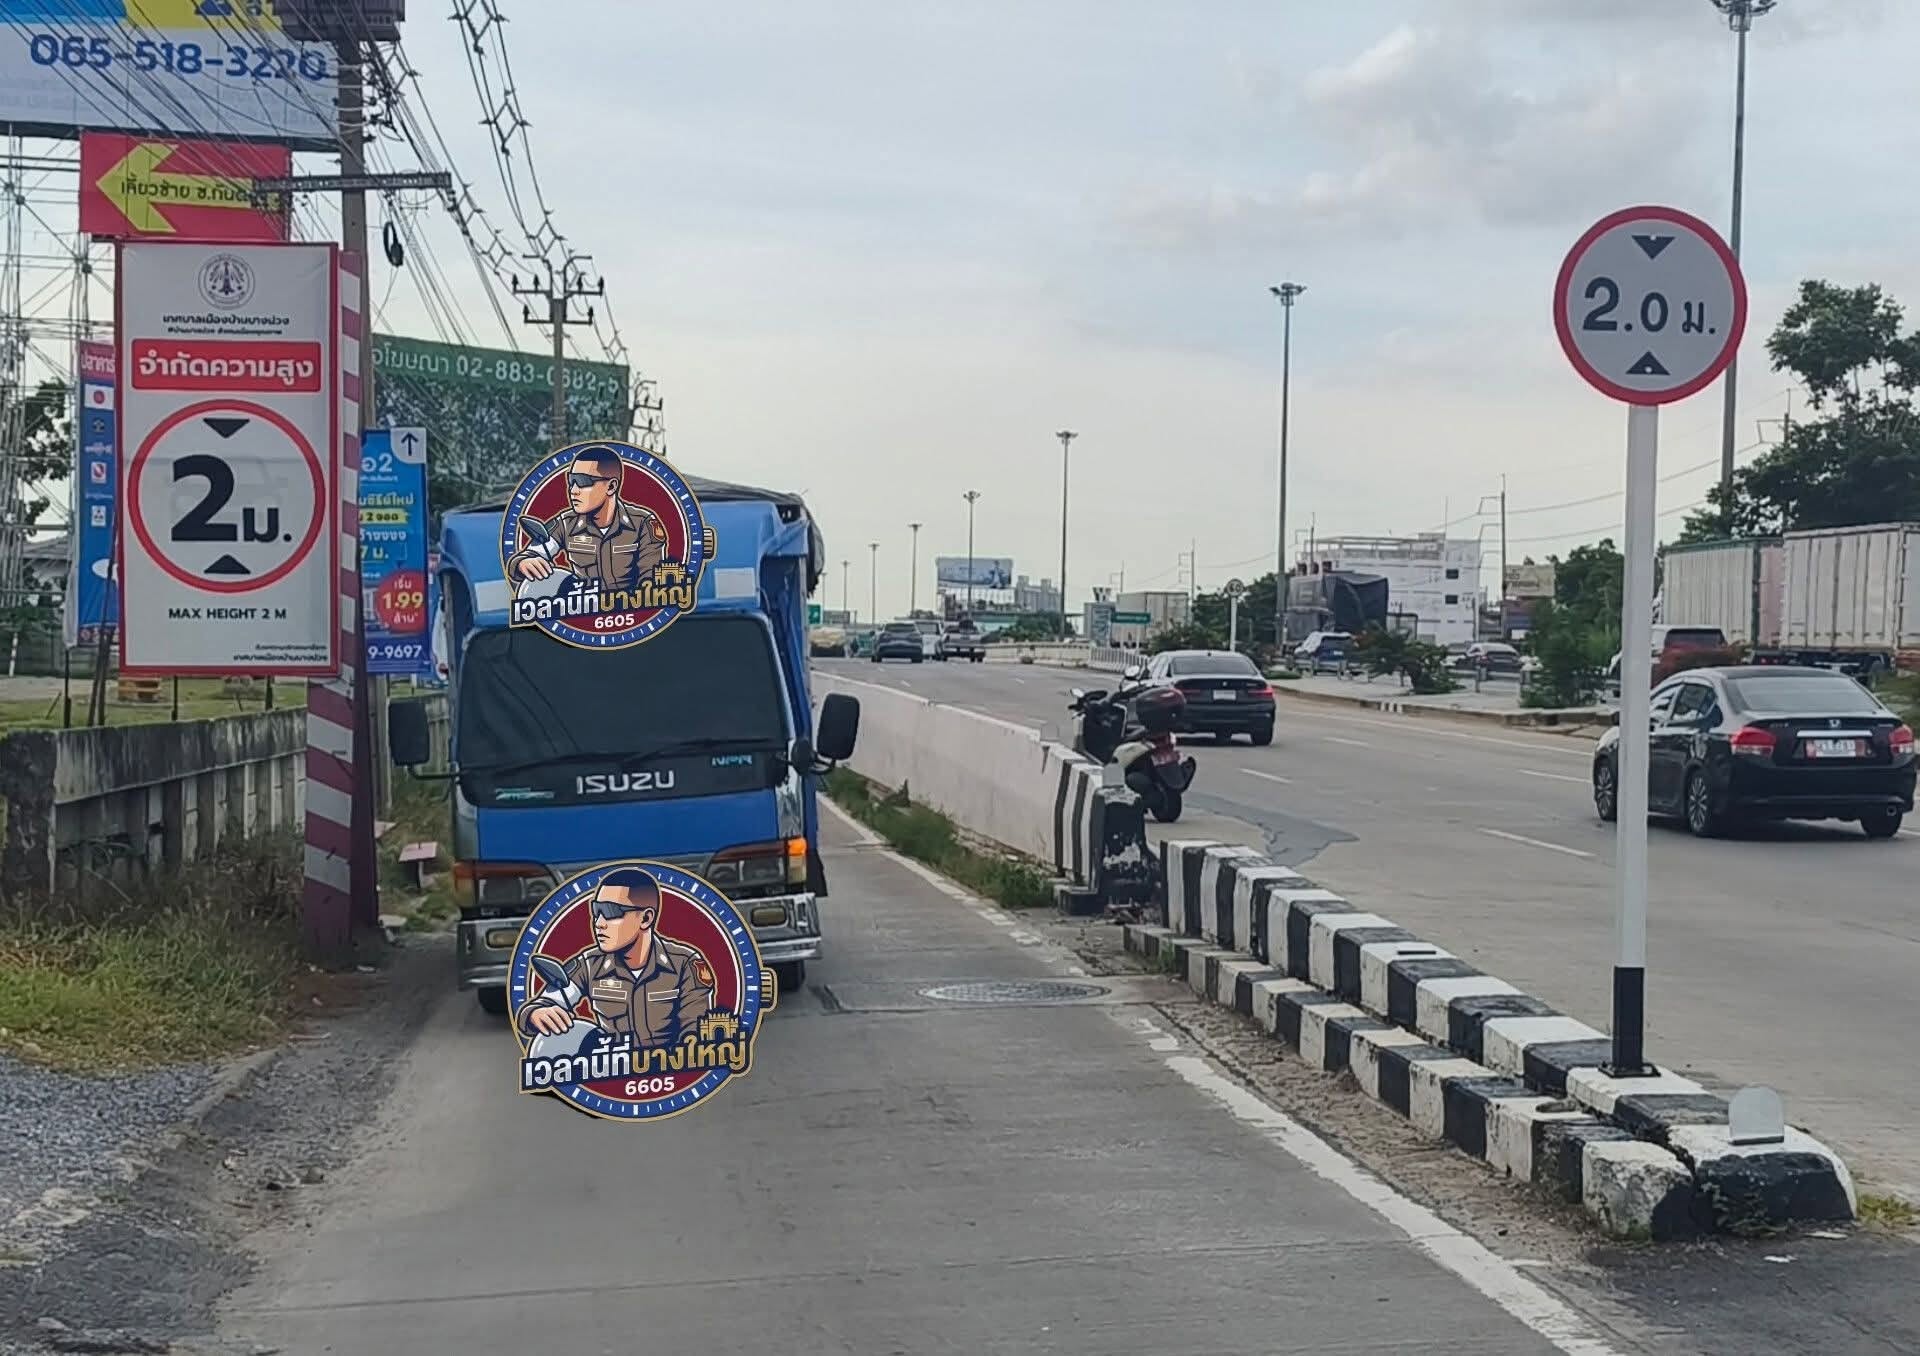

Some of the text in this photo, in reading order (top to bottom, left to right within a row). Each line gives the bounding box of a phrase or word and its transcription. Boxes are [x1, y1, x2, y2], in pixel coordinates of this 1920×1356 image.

[1582, 276, 1716, 335] 2.0 ม.
[138, 348, 315, 386] จำกัดความสูง
[382, 591, 424, 610] 1.99
[168, 607, 287, 620] MAX HEIGHT 2 M
[576, 770, 676, 795] ISUZU
